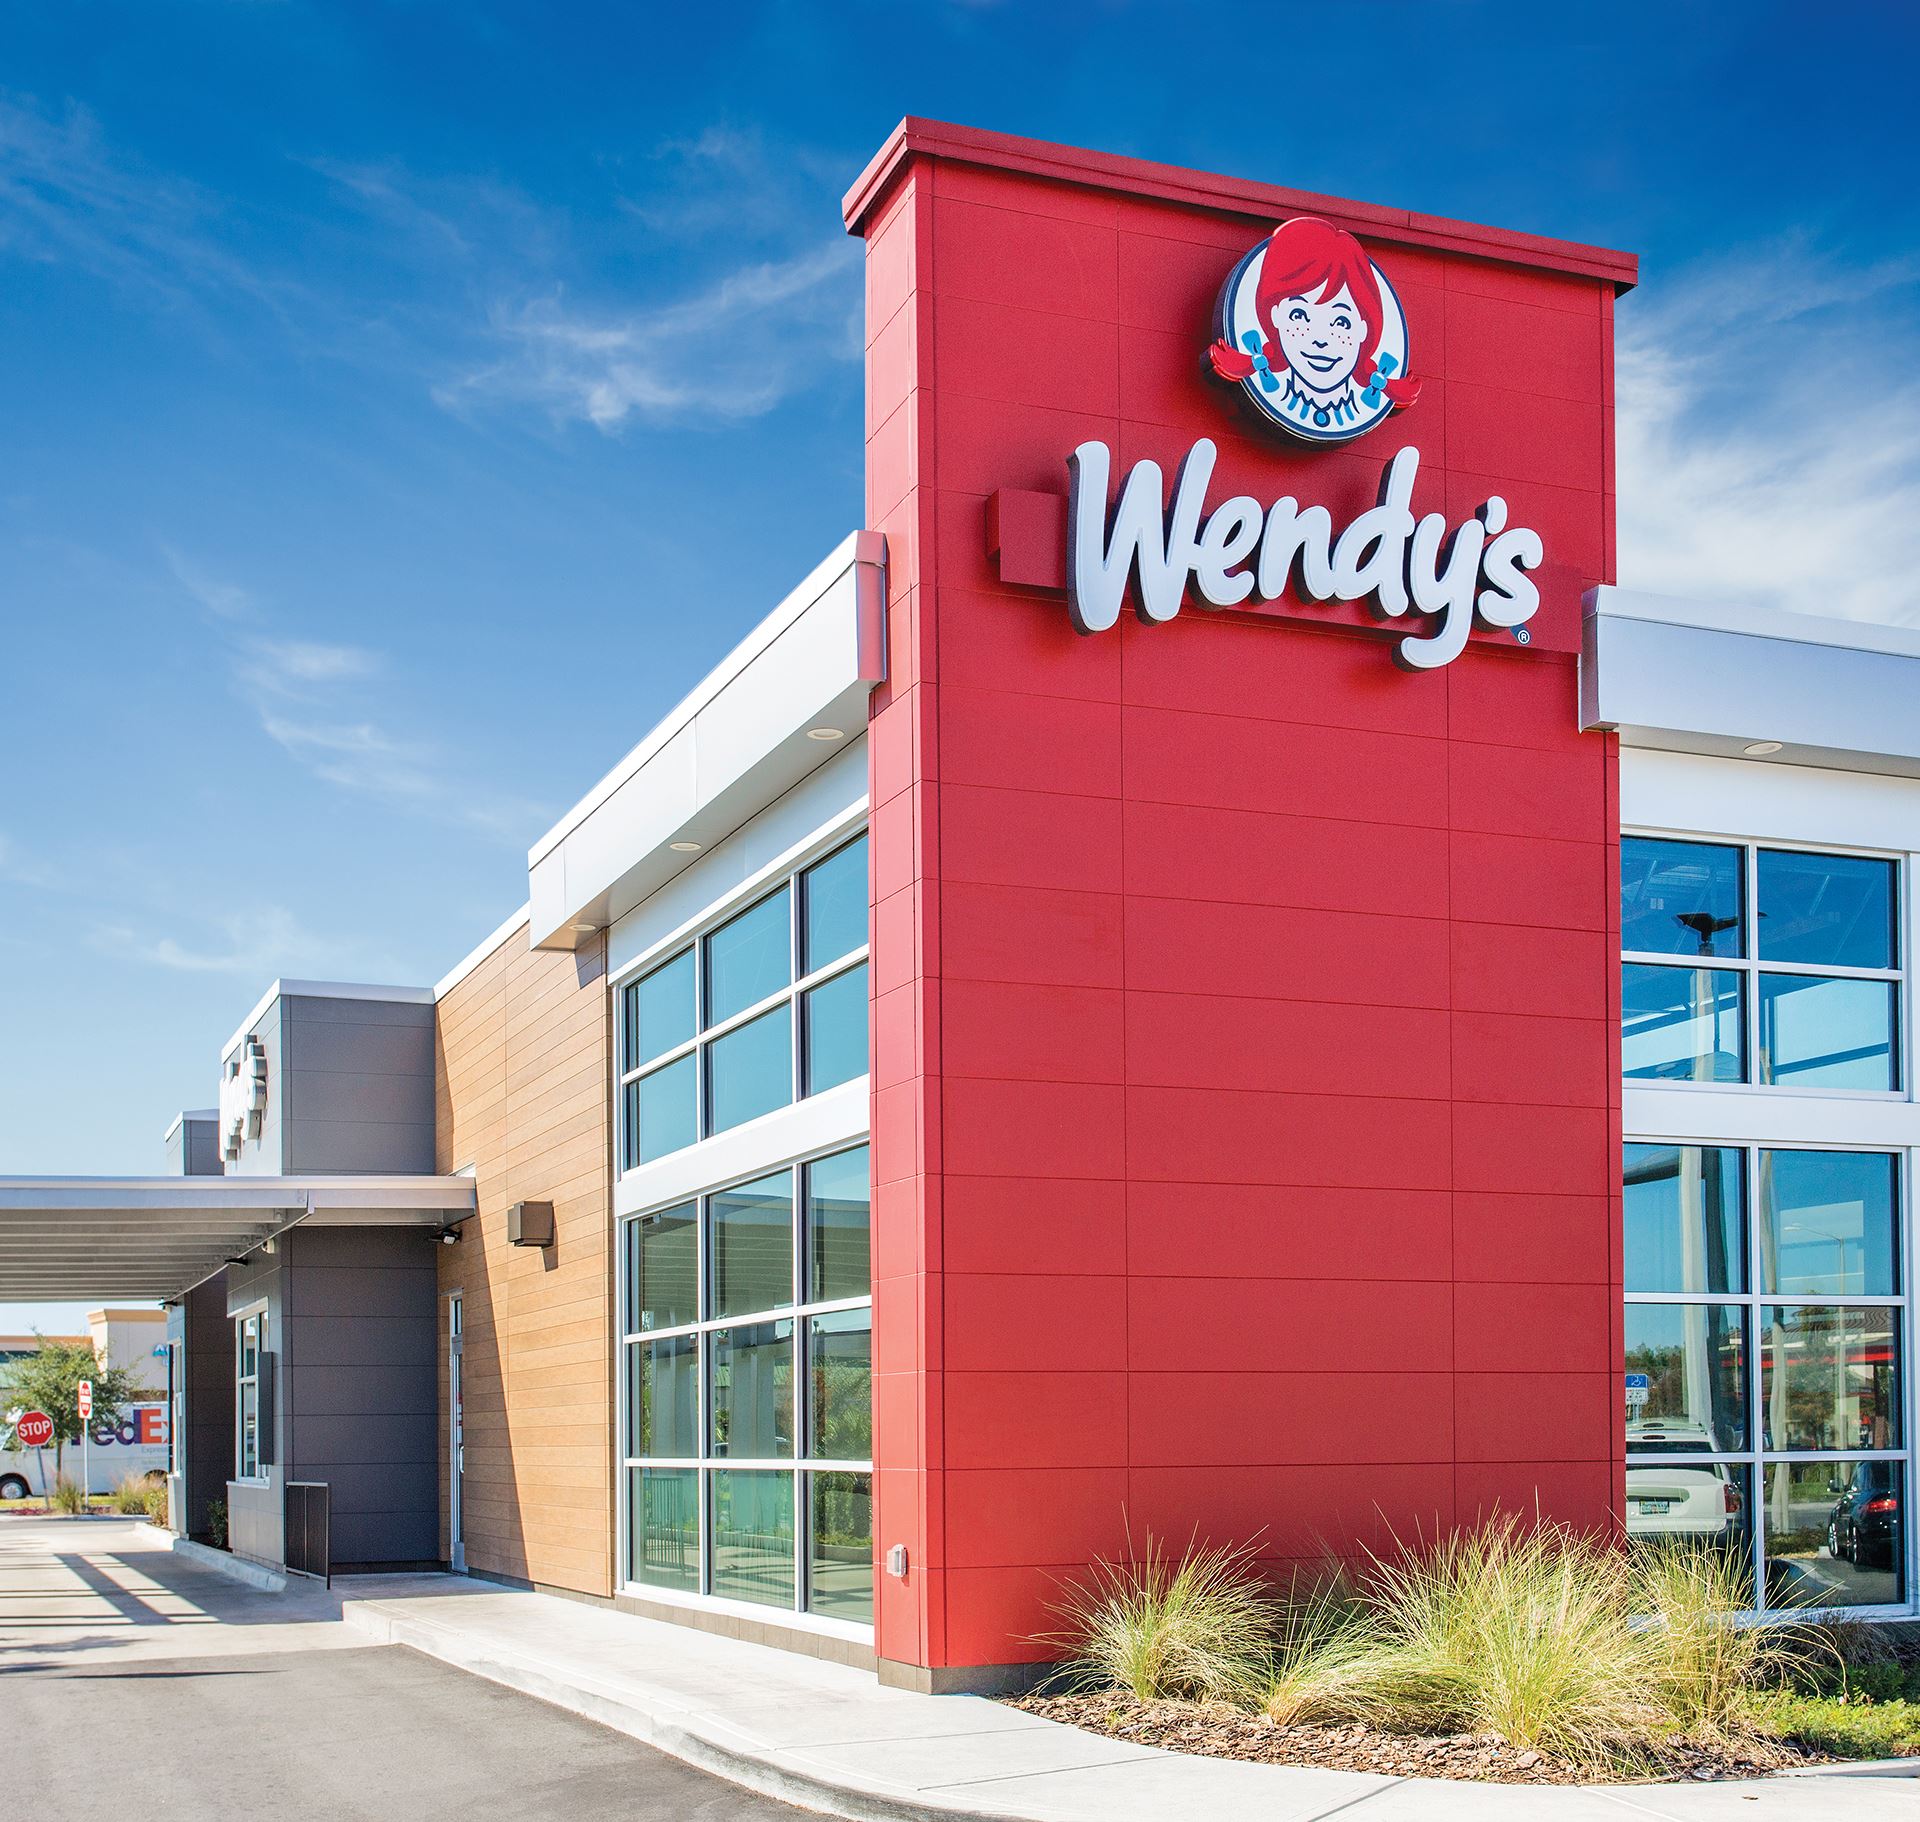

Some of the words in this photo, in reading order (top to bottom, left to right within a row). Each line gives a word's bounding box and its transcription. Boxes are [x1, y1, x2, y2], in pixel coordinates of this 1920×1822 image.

[1073, 437, 1544, 670] Wendy's
[19, 1420, 51, 1438] STOP
[71, 1408, 168, 1446] edE
